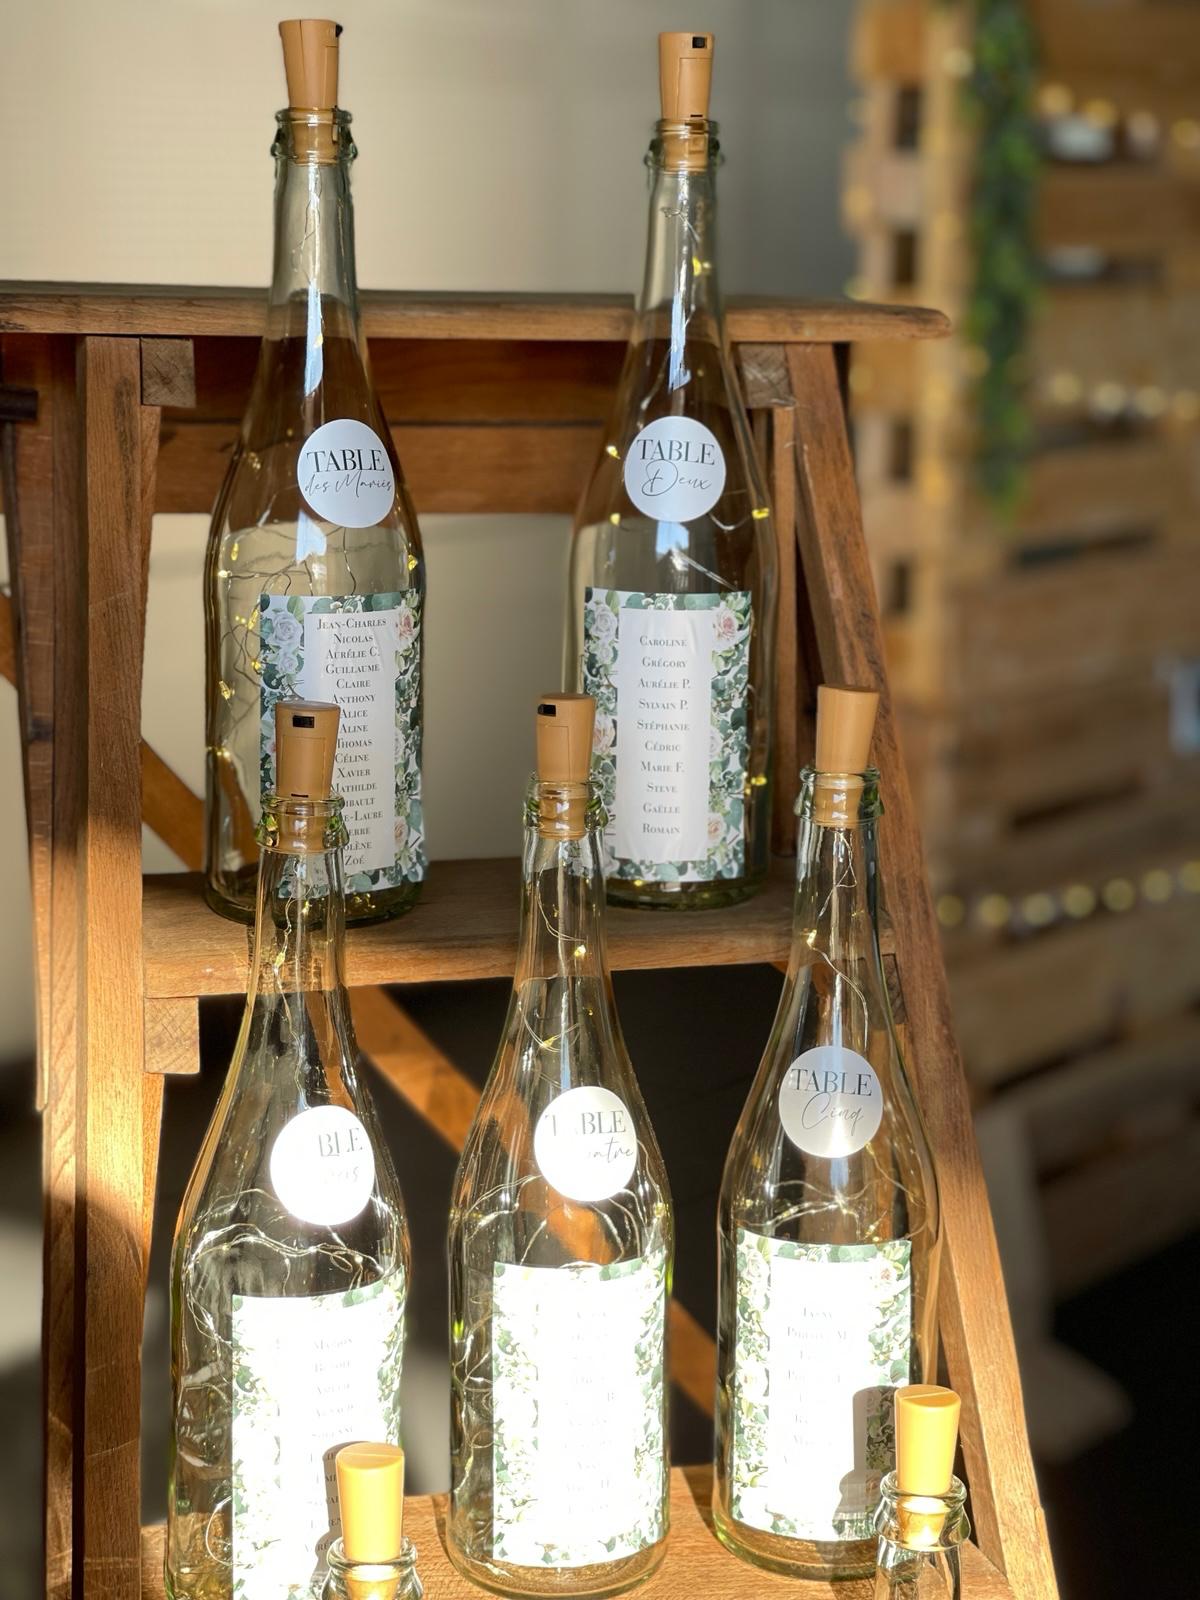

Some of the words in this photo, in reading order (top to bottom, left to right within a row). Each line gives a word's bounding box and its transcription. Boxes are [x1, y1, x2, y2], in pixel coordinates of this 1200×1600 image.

[637, 439, 715, 466] TABLE
[307, 448, 384, 473] TABLE
[641, 458, 712, 497] Deux
[305, 473, 329, 496] des
[316, 618, 387, 631] JEAN-CHARLES
[333, 633, 374, 644] NICOLAS
[639, 635, 688, 647] CAROLINE
[326, 647, 367, 660] AURÉLIE
[642, 655, 688, 668] GRÉGORY
[325, 663, 381, 675] GUILLAUME
[336, 678, 371, 689] CLAIRE
[638, 677, 679, 689] AURÉLIE
[333, 693, 376, 704] ANTHONY
[638, 698, 676, 710] SYLVAIN
[340, 708, 368, 719] ALICE
[339, 723, 369, 734] ALINE
[636, 719, 690, 731] STÉPHANIE
[337, 738, 373, 749] THOMAS
[644, 739, 681, 751] CÉDRIC
[335, 752, 370, 763] CÉLINE
[640, 761, 671, 772] MARIE
[337, 767, 371, 779] XAVIER
[646, 781, 678, 793] STEVE
[642, 823, 681, 834] ROMAIN
[344, 854, 365, 866] ZOÉ
[791, 1068, 872, 1097] TABLE
[801, 1091, 864, 1136] Cinq
